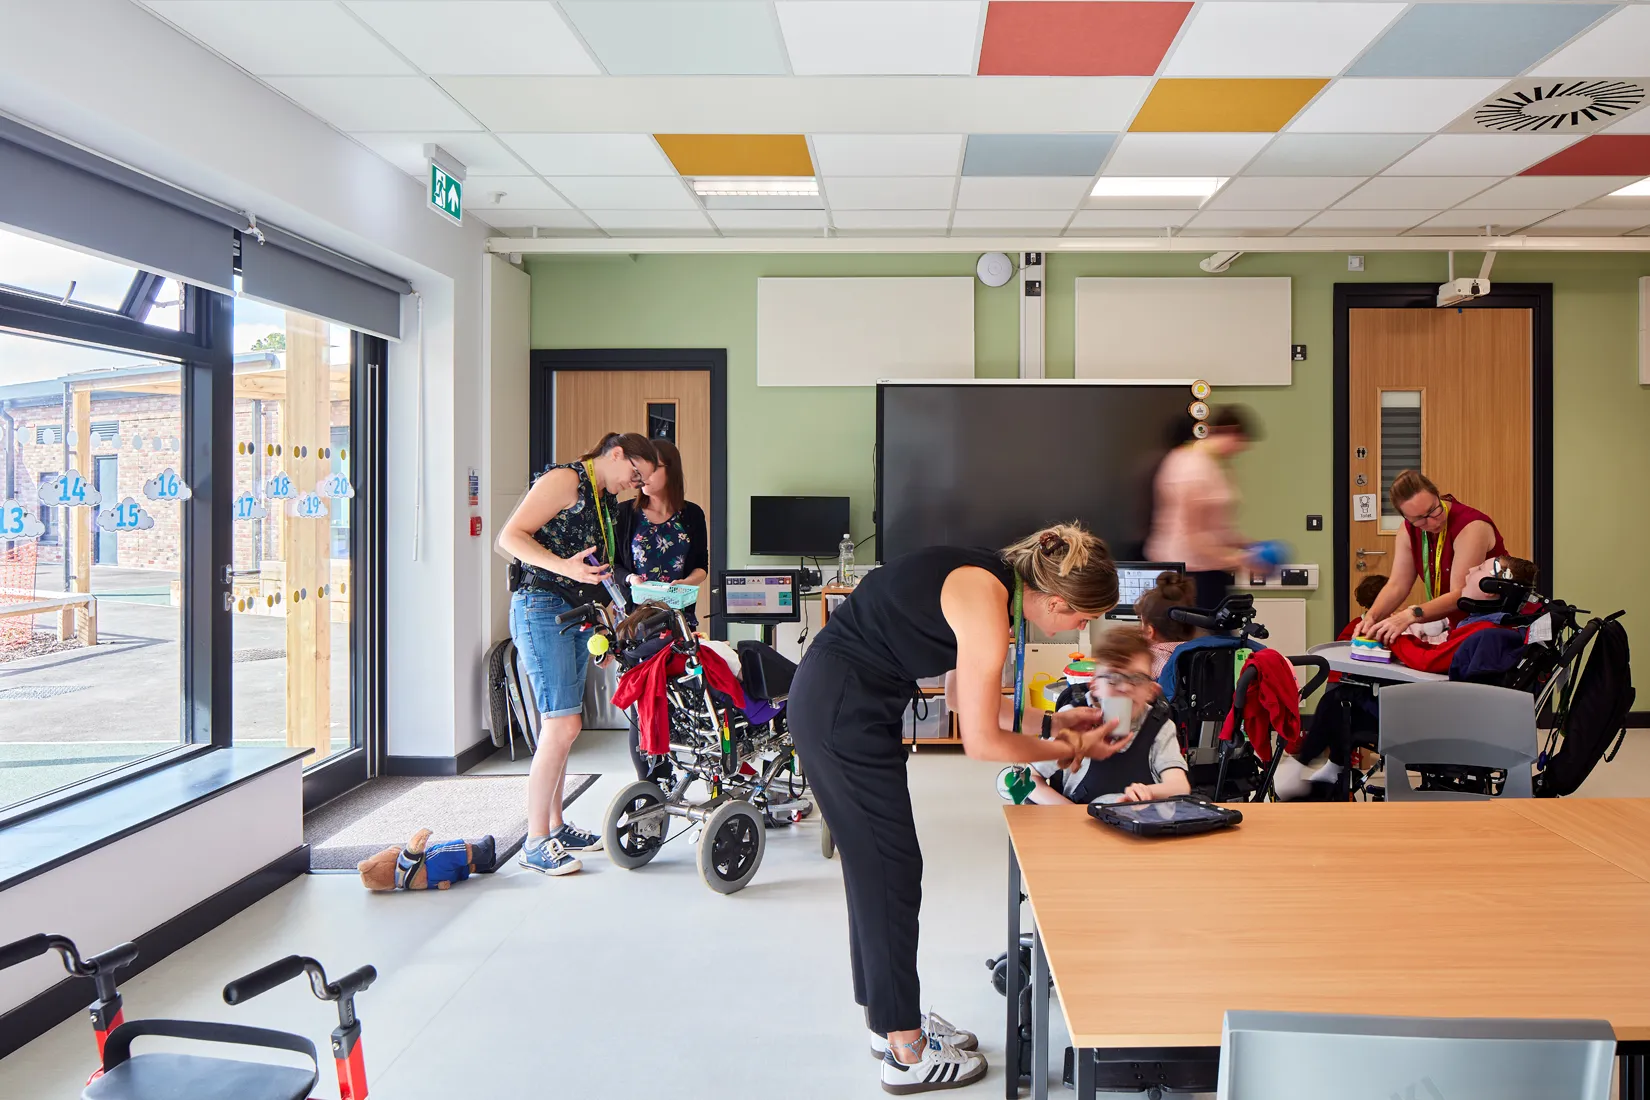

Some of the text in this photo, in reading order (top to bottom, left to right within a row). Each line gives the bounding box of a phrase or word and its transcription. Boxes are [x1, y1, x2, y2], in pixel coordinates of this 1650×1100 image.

[58, 476, 86, 502] 14
[158, 474, 179, 497] 16
[273, 476, 290, 496] 18
[333, 477, 348, 495] 20
[116, 504, 139, 527] 15
[238, 497, 254, 517] 17
[306, 496, 319, 514] 19
[0, 507, 24, 534] 13
